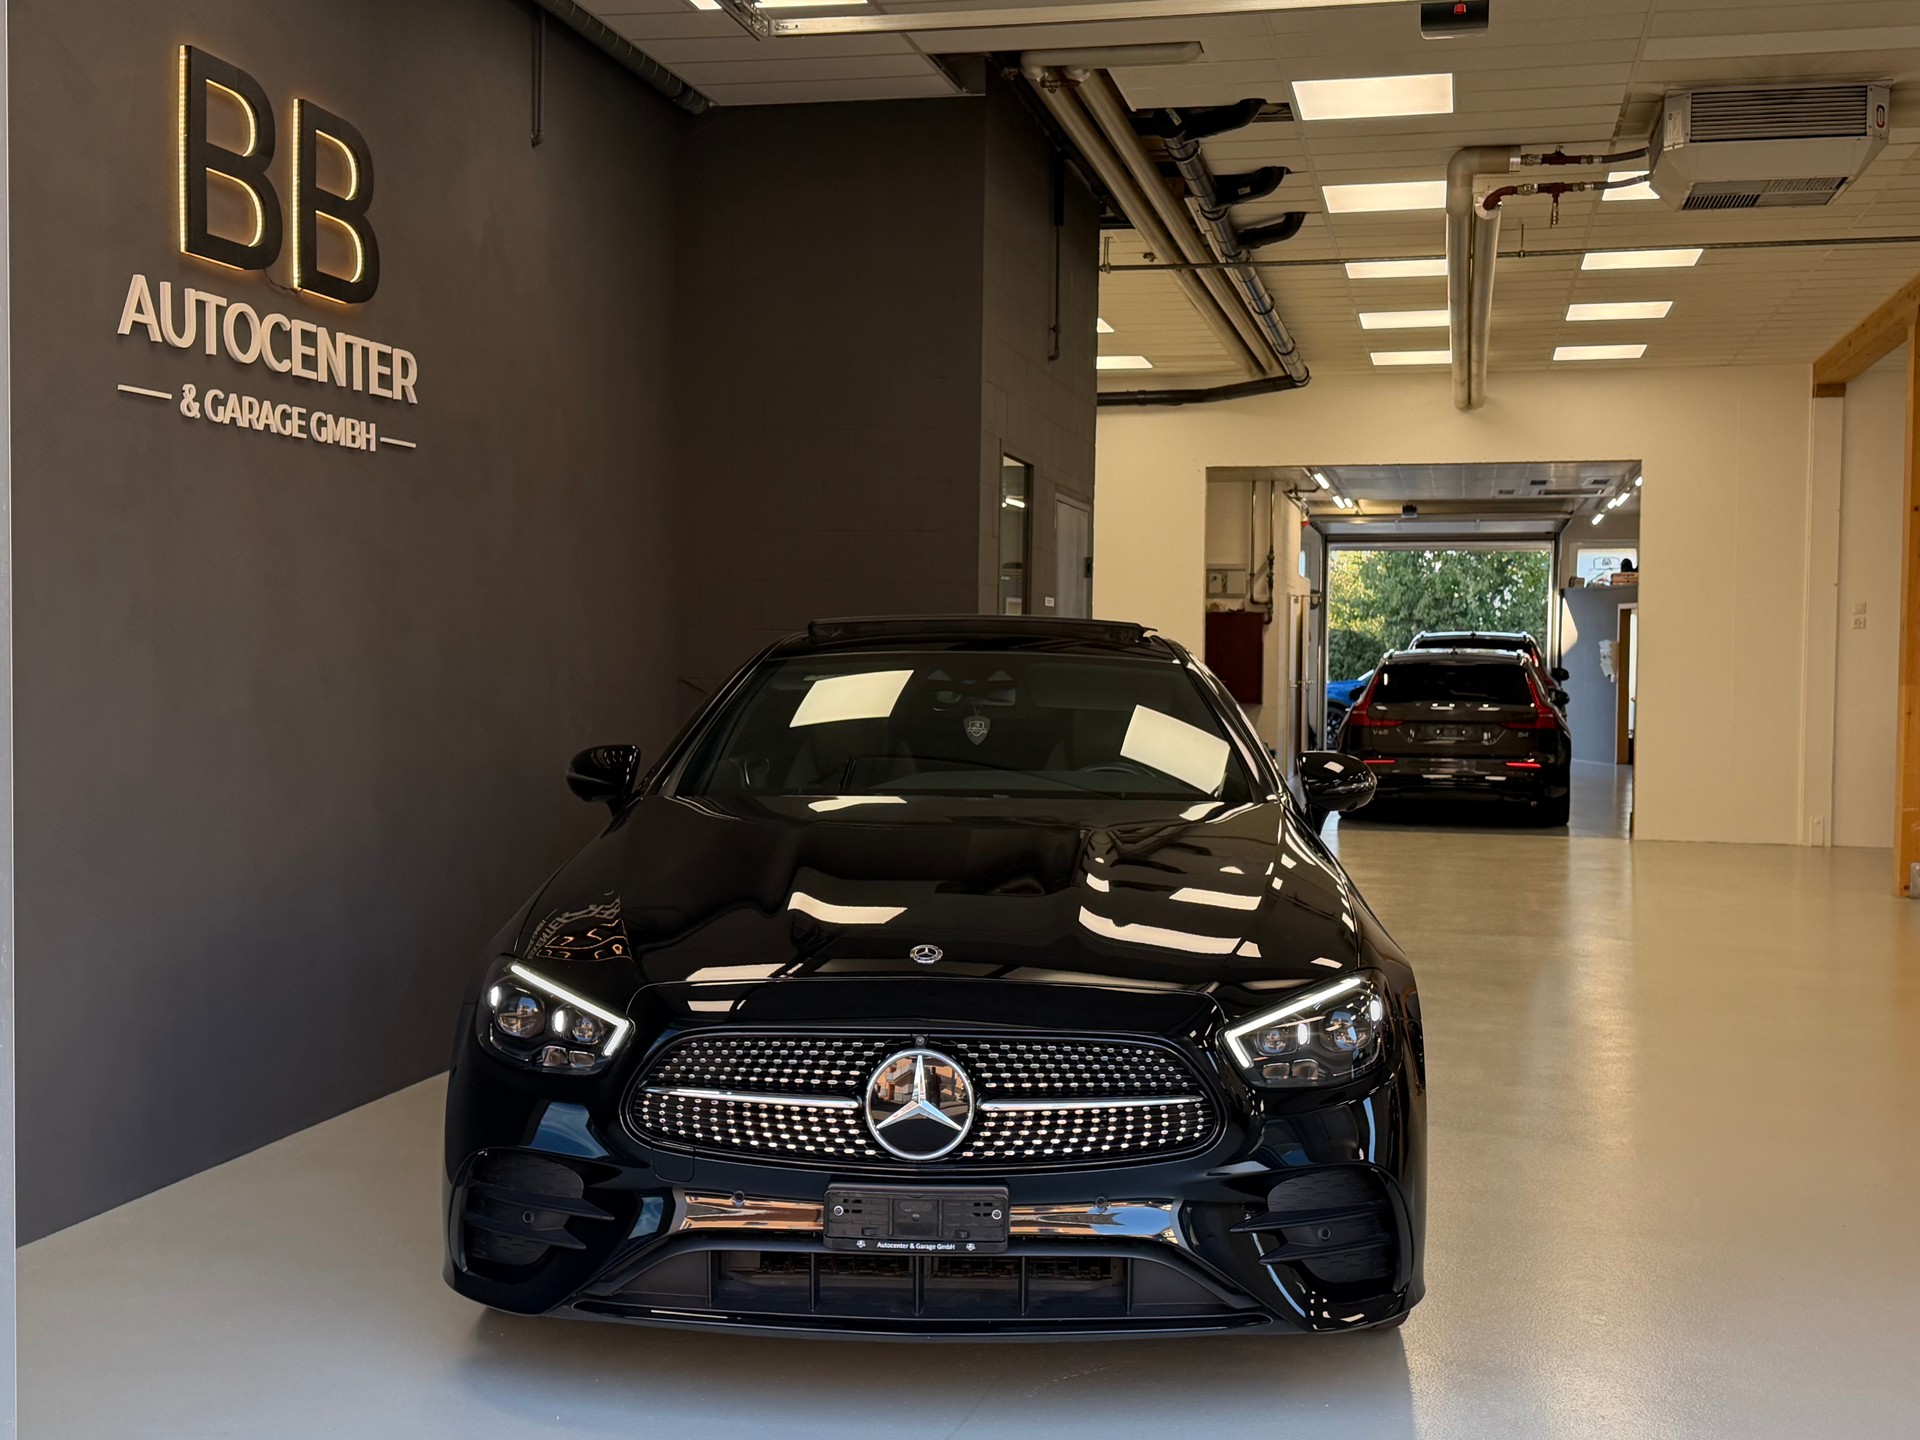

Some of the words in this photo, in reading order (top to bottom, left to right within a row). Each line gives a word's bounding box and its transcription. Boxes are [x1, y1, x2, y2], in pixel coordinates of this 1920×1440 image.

[179, 45, 381, 304] BB
[117, 273, 418, 404] AUTOCENTER
[180, 383, 200, 419] &
[204, 388, 307, 439] GARAGE
[310, 411, 376, 452] GMBH
